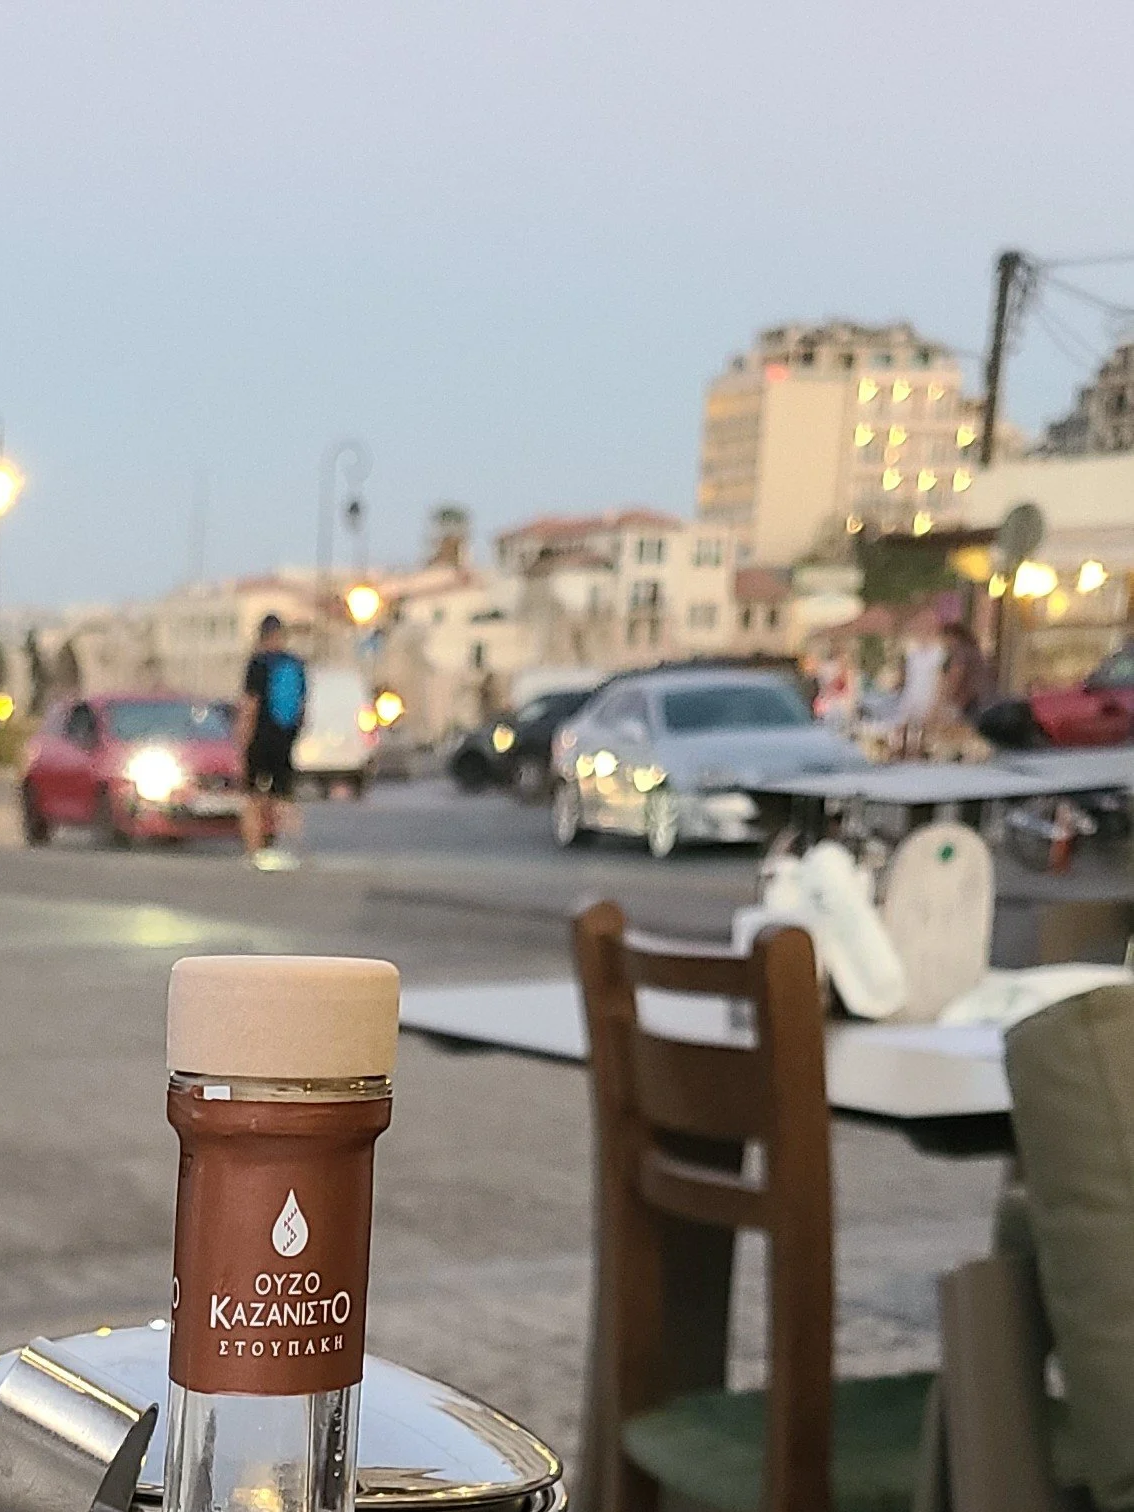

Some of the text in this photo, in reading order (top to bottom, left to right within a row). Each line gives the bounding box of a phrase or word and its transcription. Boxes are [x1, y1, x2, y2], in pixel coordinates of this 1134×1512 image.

[255, 1272, 320, 1295] ΟΥΖΟ
[210, 1291, 351, 1329] ΚΑΖΑΝΙΣΤΟ
[219, 1335, 344, 1357] ΣΤΟΥΠΑΚΗ
